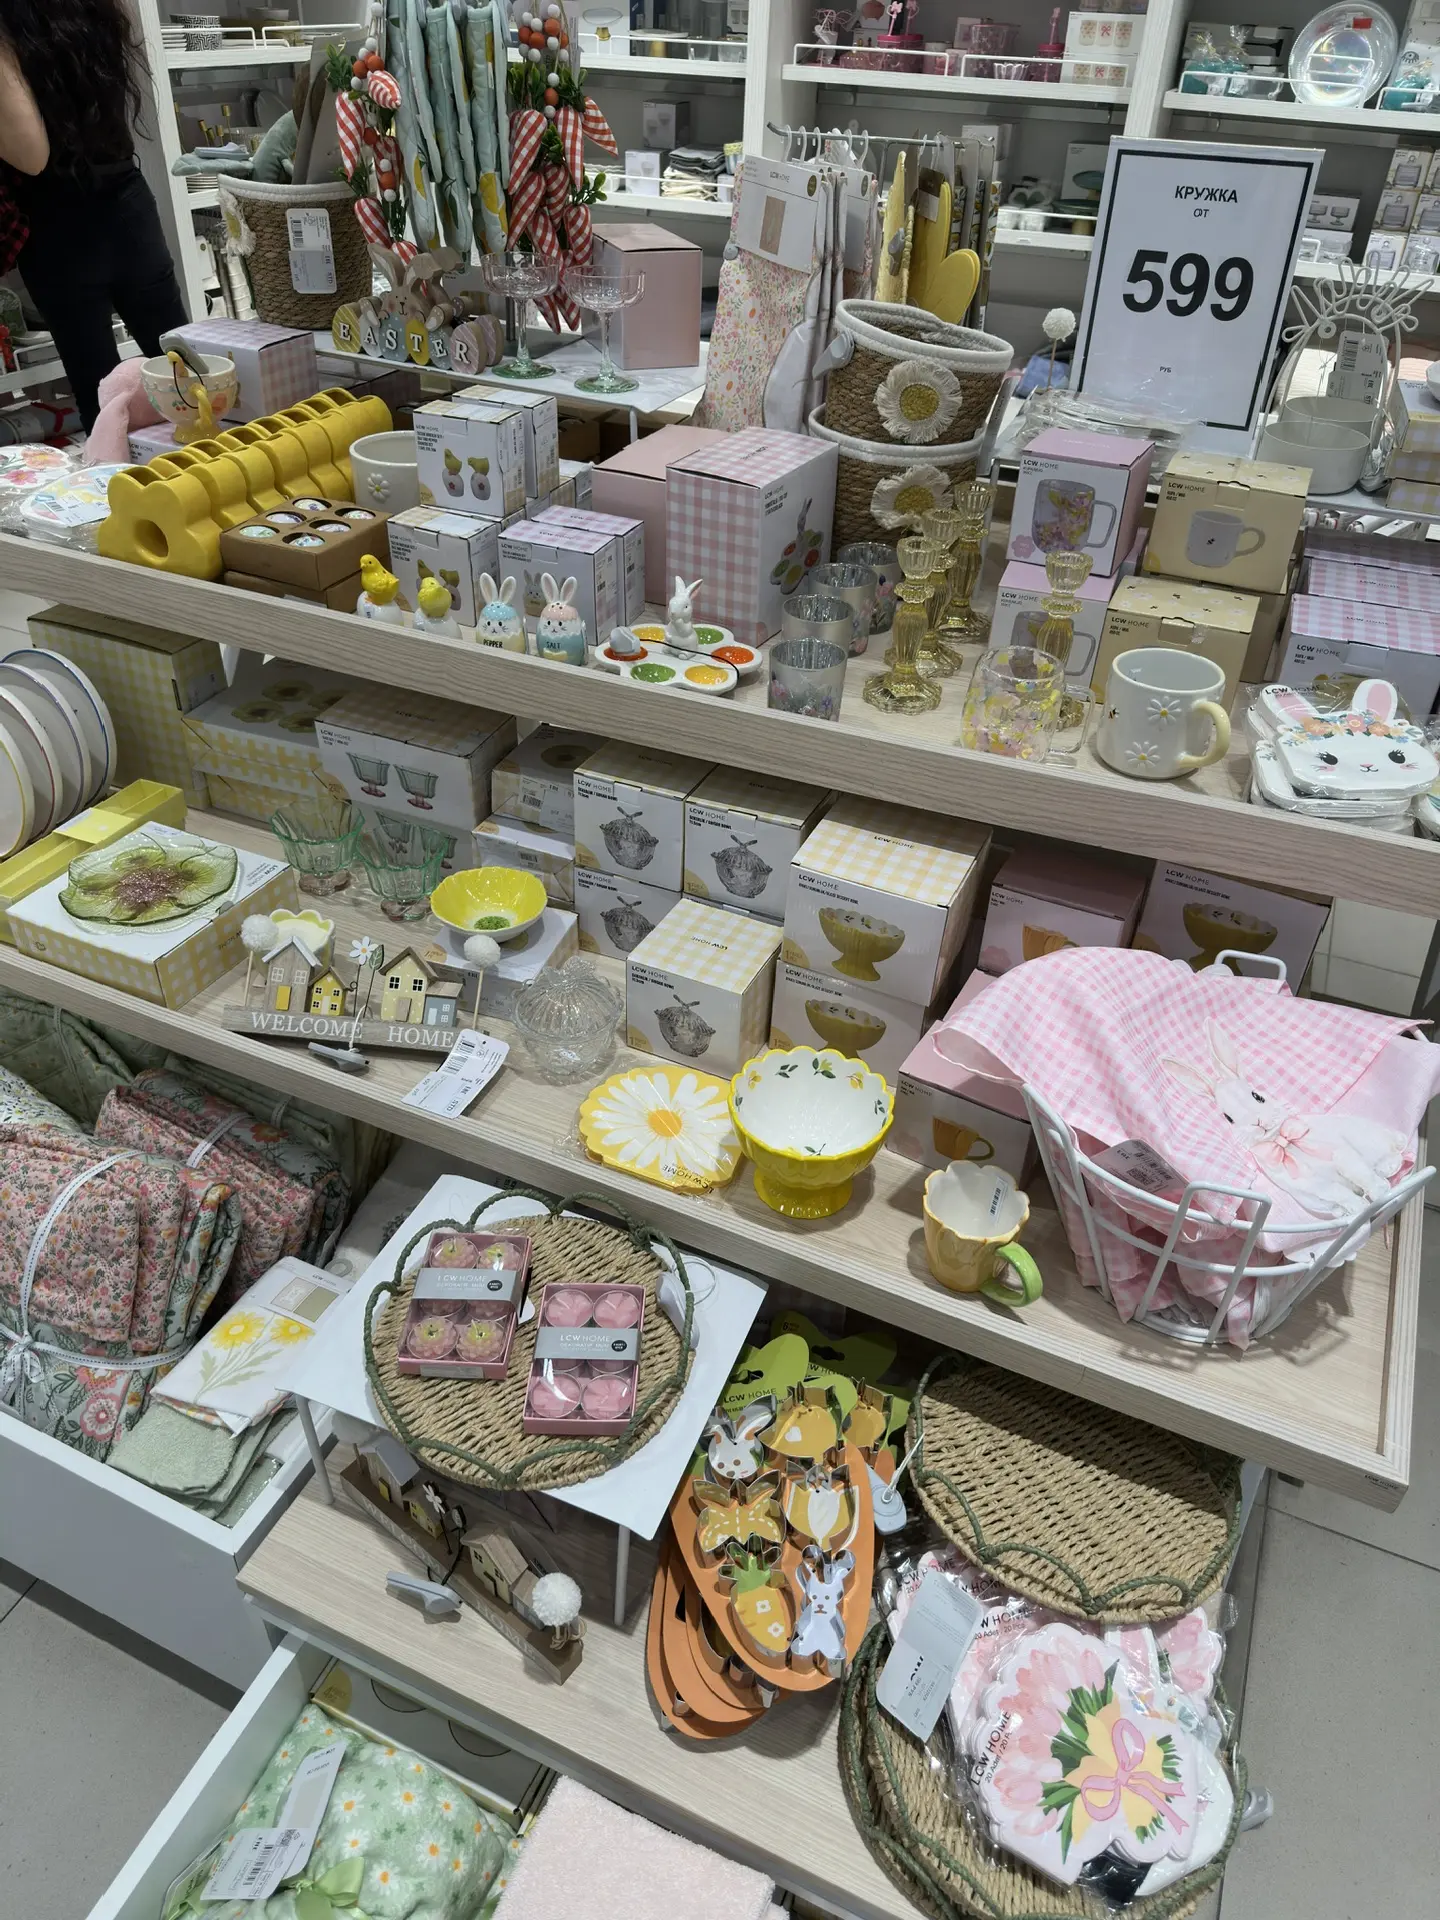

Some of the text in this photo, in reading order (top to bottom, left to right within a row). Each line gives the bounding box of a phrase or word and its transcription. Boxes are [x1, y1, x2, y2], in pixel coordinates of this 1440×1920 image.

[1174, 186, 1238, 203] КРУЖКА
[1193, 208, 1209, 218] ОТ
[1122, 249, 1254, 321] 599
[339, 321, 471, 365] EASTER
[1040, 462, 1059, 470] HOME
[1184, 485, 1205, 493] HOME
[1018, 594, 1038, 602] HOME
[1111, 616, 1150, 628] LCW HOME
[483, 638, 504, 648] PEPPER
[546, 641, 561, 649] SALT
[1296, 644, 1341, 658] LCW HOME
[1265, 687, 1288, 695] LCW
[320, 729, 333, 737] LCW
[578, 778, 612, 793] LCW HOME
[705, 812, 726, 820] HOME
[578, 871, 612, 884] LCW HOME
[798, 874, 816, 884] LCW
[816, 880, 839, 890] HOME
[1166, 868, 1184, 878] LCW
[1185, 874, 1210, 886] HOME
[632, 966, 668, 981] LCW HOME
[786, 968, 802, 977] LCW
[802, 974, 824, 984] HOME
[250, 1011, 455, 1048] WELCOME HOME
[662, 1164, 714, 1194] LCW HOME
[437, 1274, 488, 1282] LCW HOME
[724, 1388, 776, 1404] LCW HOME
[970, 1711, 1012, 1786] LCW HOME
[984, 1772, 993, 1784] 20
[1000, 1739, 1008, 1750] 20
